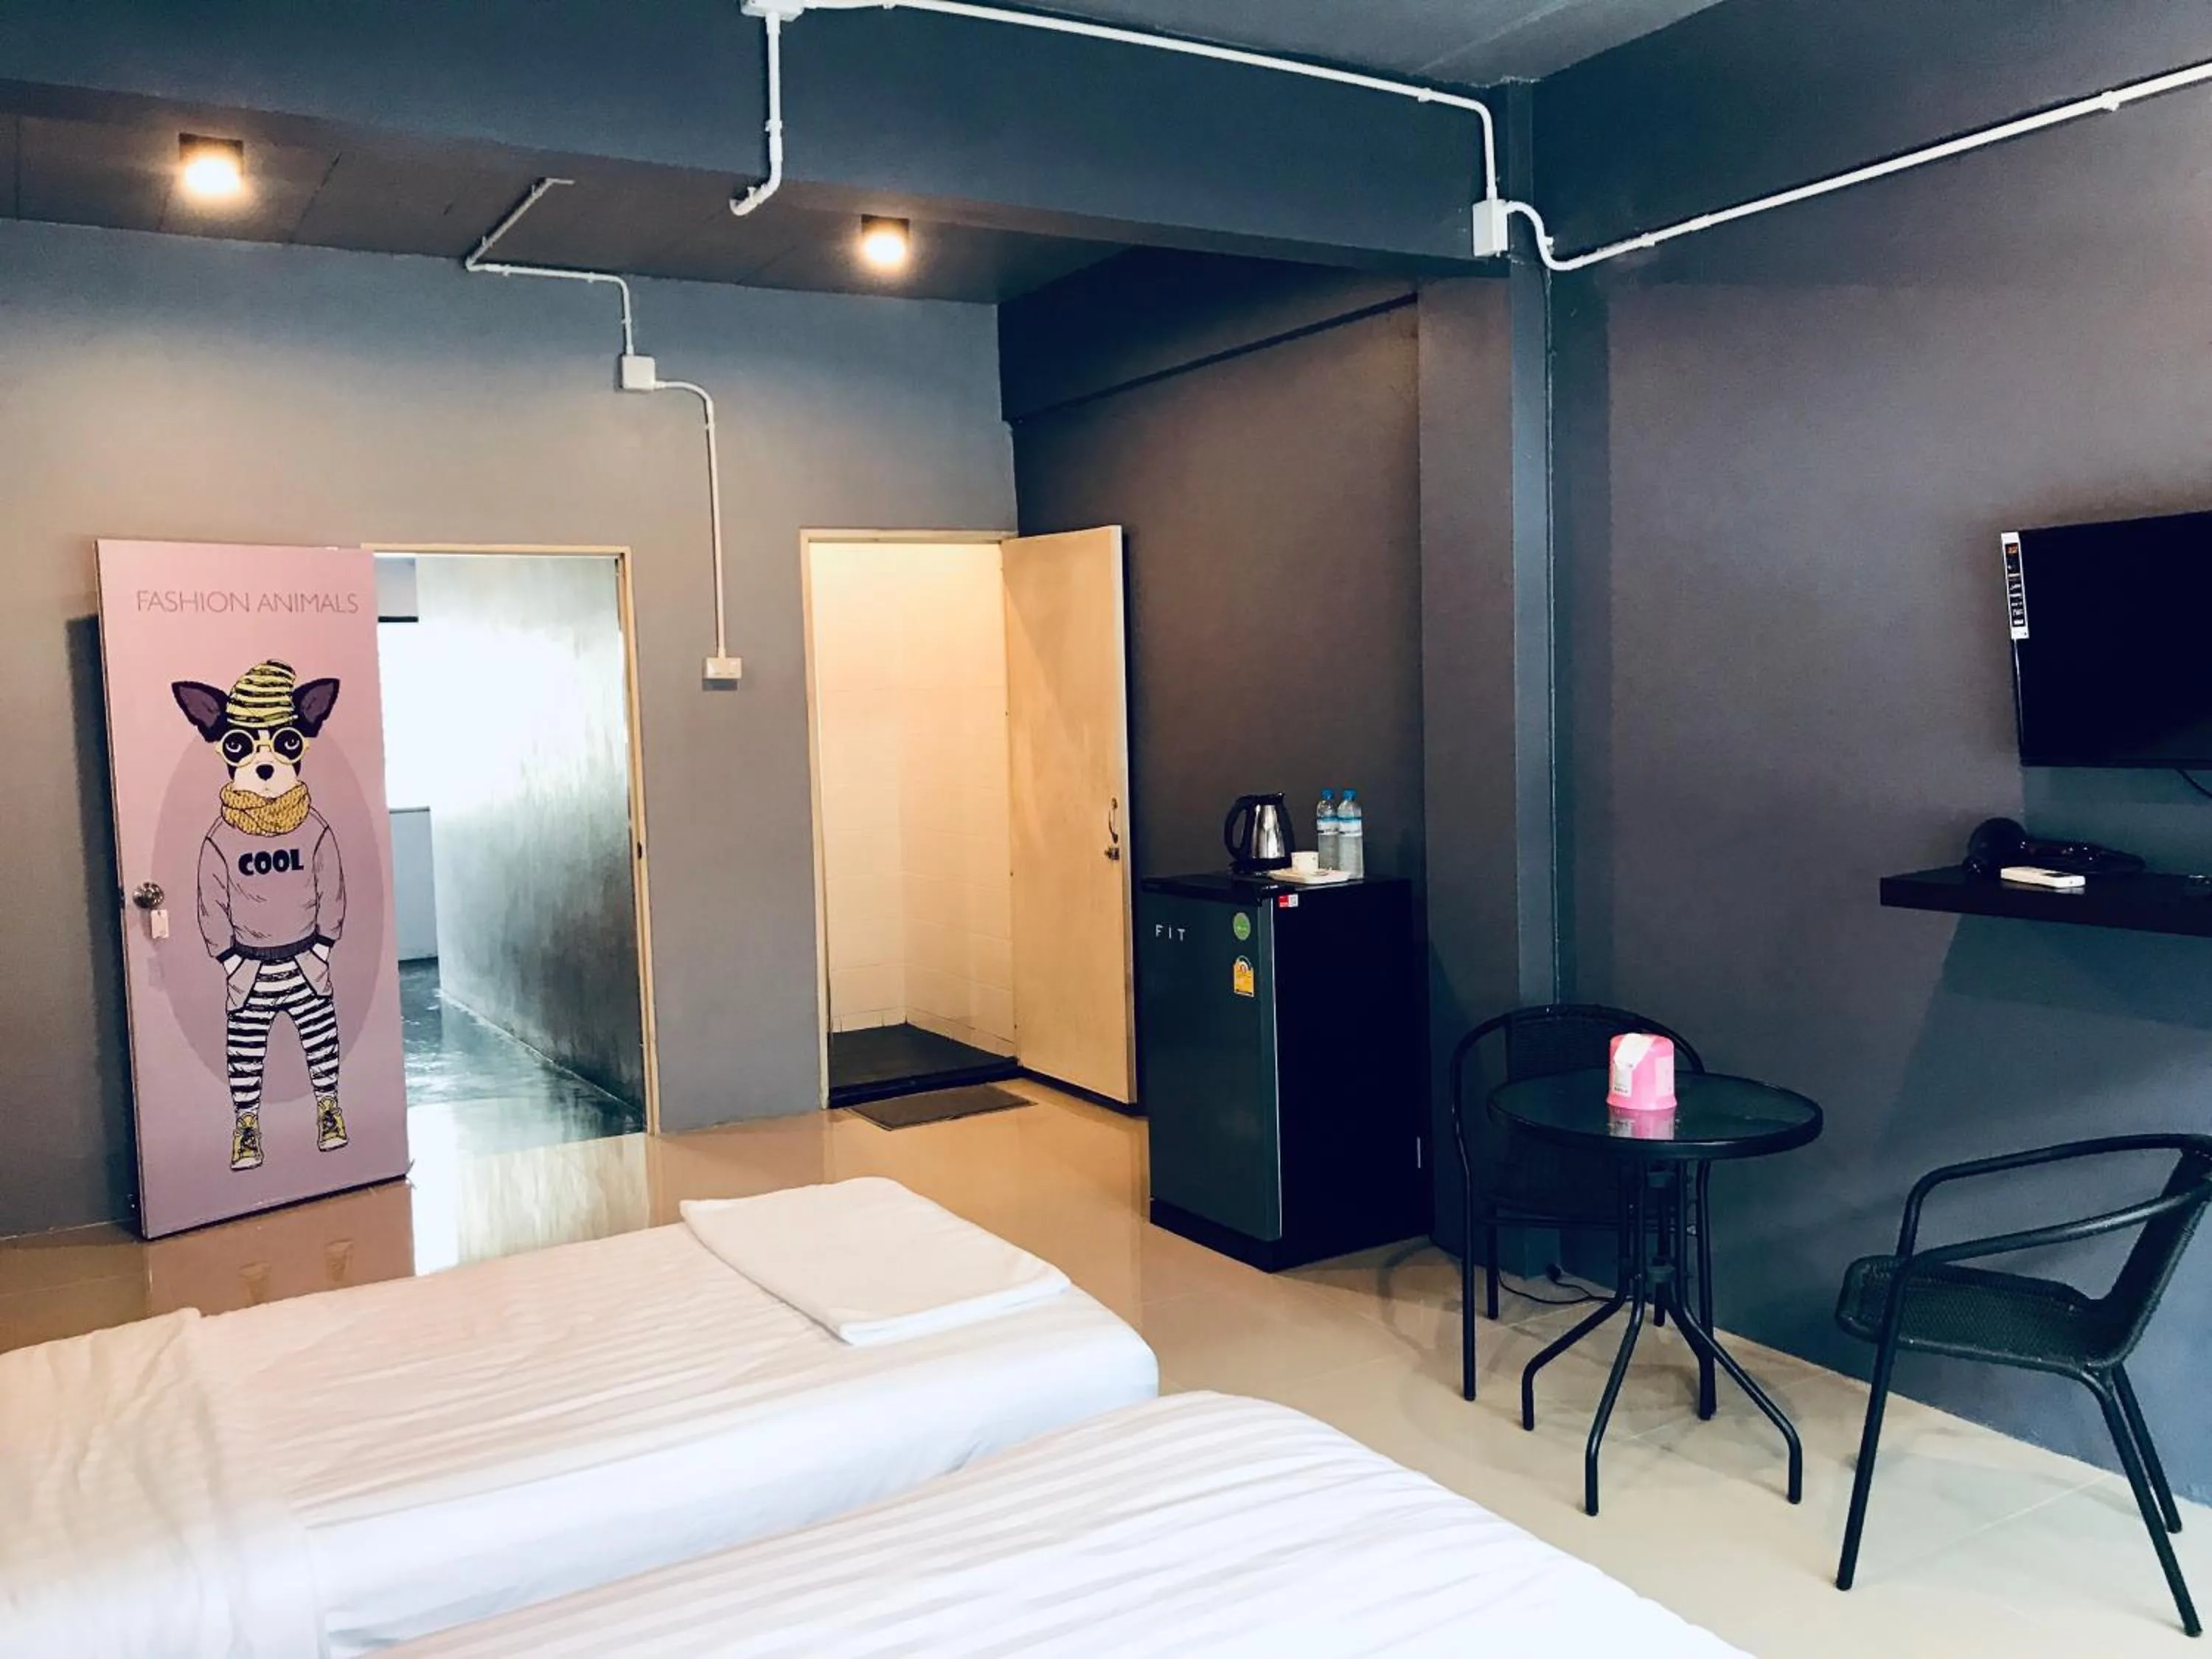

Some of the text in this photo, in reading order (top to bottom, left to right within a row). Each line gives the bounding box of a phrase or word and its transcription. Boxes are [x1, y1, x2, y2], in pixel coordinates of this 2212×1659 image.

[136, 590, 360, 614] FASHION ANIMALS
[238, 849, 305, 876] COOL
[1155, 924, 1186, 942] FIT
